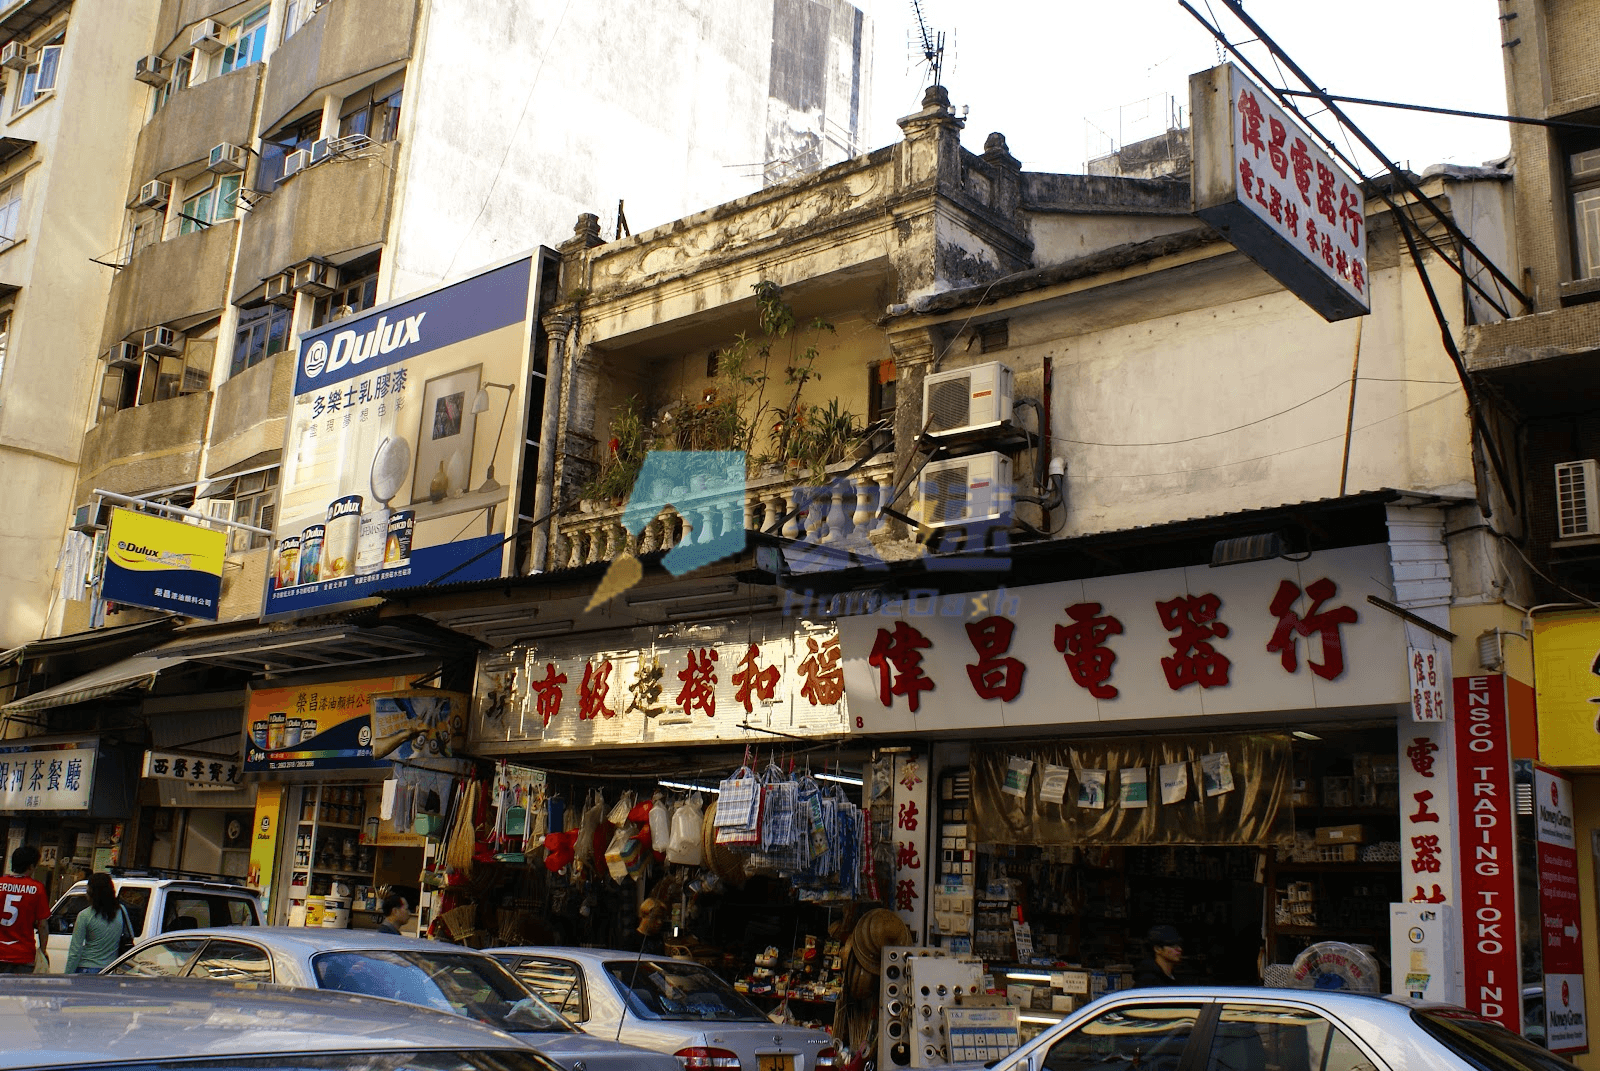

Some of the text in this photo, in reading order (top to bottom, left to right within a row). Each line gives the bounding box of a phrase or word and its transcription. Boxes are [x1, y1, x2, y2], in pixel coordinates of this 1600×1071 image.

[1237, 88, 1363, 248] 偉昌電器行
[1239, 157, 1299, 238] 電工器材
[309, 347, 324, 363] ICI
[325, 311, 427, 374] Dulux
[312, 367, 408, 420] 多樂士乳膠漆
[333, 499, 360, 516] Dulux
[126, 542, 159, 558] Dulux
[306, 527, 325, 540] Dulux
[868, 576, 1359, 714] 偉昌電器行
[1413, 650, 1437, 688] 偉昌
[1413, 688, 1444, 721] 電器行
[855, 716, 864, 729] 8
[257, 833, 270, 841] Dulux
[1468, 677, 1506, 1028] ENSCO TRADING TOKO IND
[1, 894, 23, 927] 5
[1549, 1009, 1583, 1030] MoneyGram
